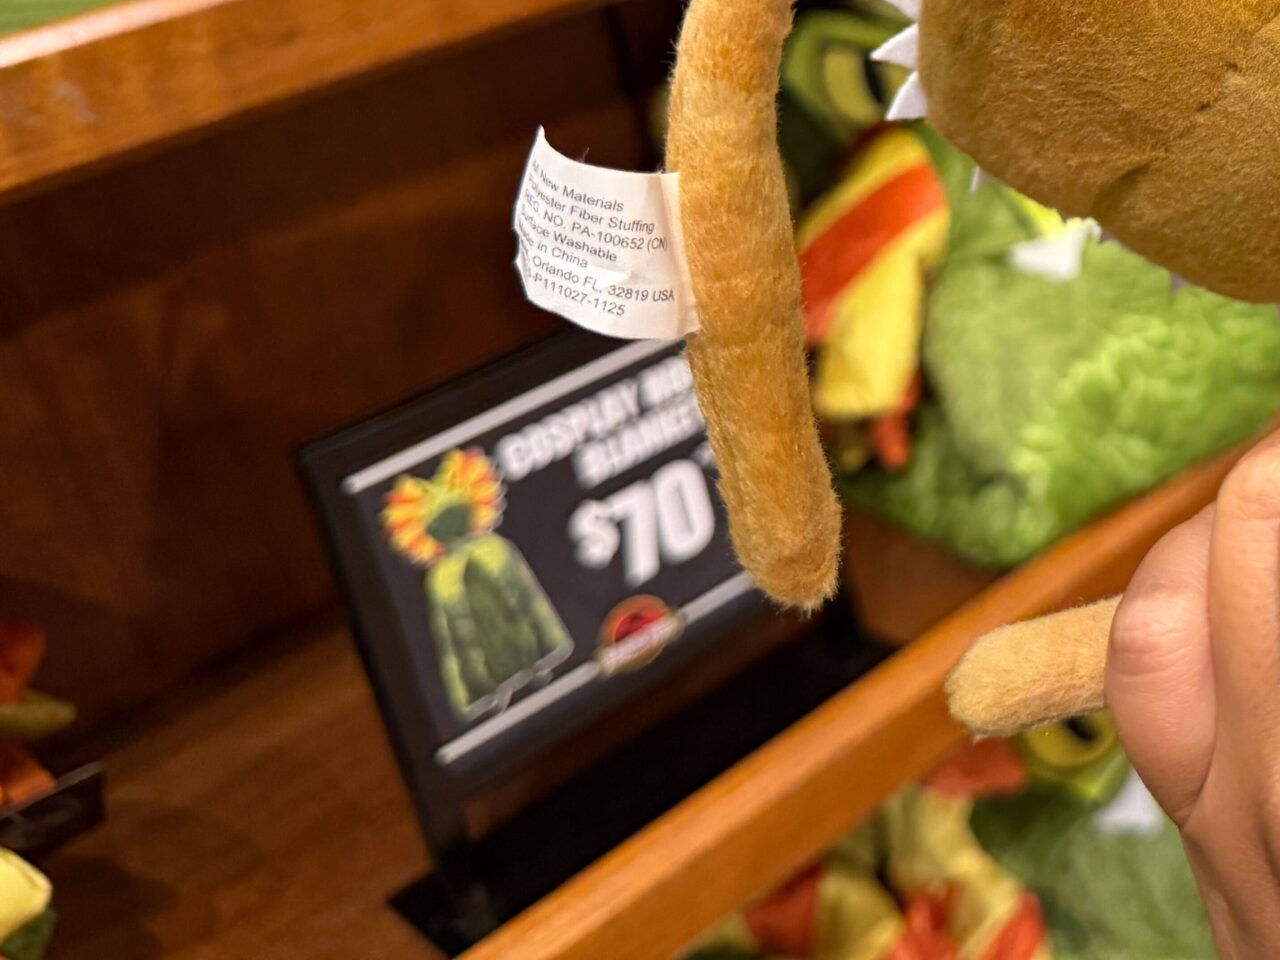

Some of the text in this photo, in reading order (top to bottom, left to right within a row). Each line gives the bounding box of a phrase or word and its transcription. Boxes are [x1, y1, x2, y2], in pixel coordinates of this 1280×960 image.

[540, 169, 560, 192] New
[562, 184, 625, 213] Materials
[570, 205, 604, 225] Fiber
[608, 216, 655, 235] Stuffing
[571, 221, 645, 250] PA-100652
[646, 236, 668, 254] (CN)
[537, 242, 548, 253] in
[551, 246, 588, 269] China
[553, 230, 618, 262] Washable
[532, 255, 580, 284] Orlando
[607, 284, 649, 301] 32819
[652, 289, 675, 303] USA
[495, 375, 641, 483] COSPLAY
[568, 457, 716, 588] $70
